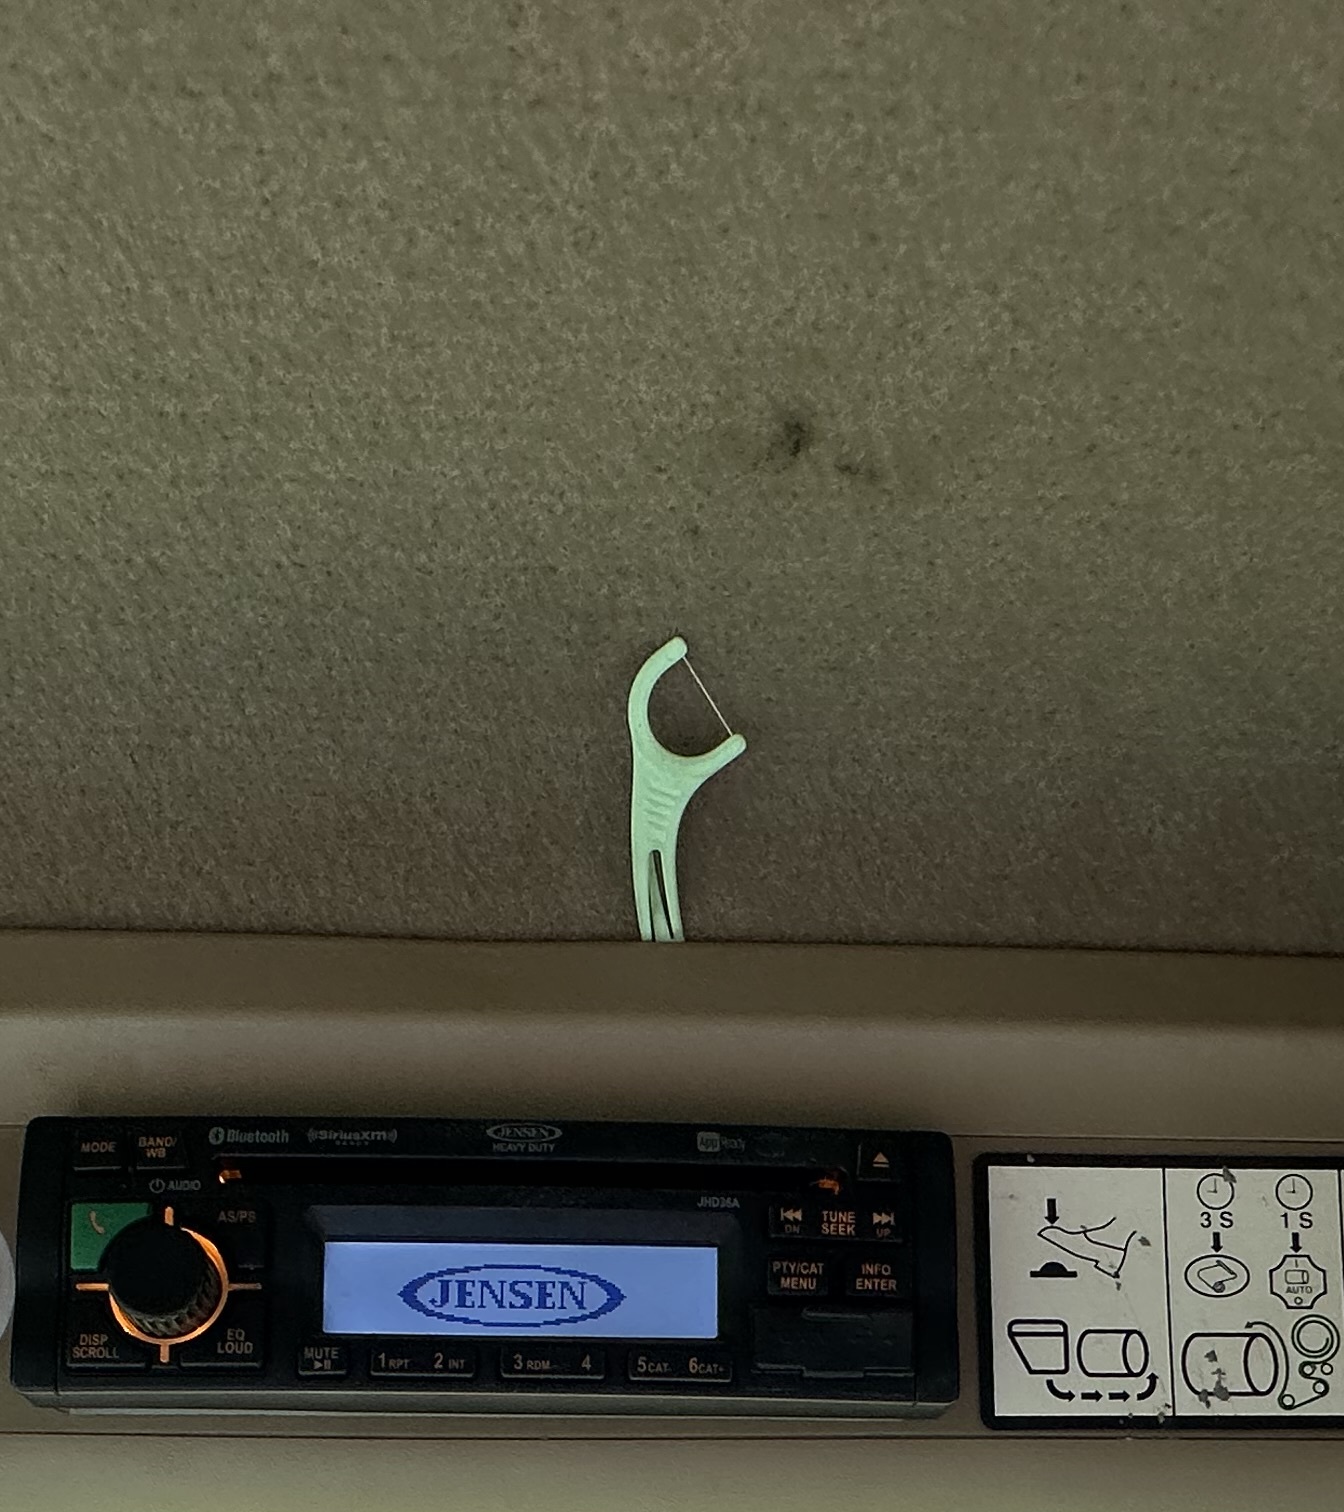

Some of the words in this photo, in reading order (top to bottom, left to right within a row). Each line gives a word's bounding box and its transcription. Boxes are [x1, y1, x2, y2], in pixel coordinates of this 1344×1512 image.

[226, 1128, 289, 1143] Bluetooth
[497, 1127, 550, 1138] JENSEN
[80, 1140, 117, 1153] MODE
[492, 1142, 526, 1152] HEAVY
[529, 1143, 555, 1152] DUTY
[145, 1148, 167, 1159] WB
[165, 1180, 202, 1191] AUDIO
[217, 1210, 257, 1224] AS/PS
[821, 1210, 856, 1223] TUNE
[1200, 1211, 1212, 1229] 3
[1219, 1211, 1234, 1229] S
[1280, 1212, 1289, 1229] 1
[1299, 1212, 1313, 1229] S
[821, 1223, 856, 1237] SEEK
[876, 1228, 892, 1238] UP
[772, 1261, 824, 1275] PTY/CAT
[861, 1263, 892, 1276] INFO
[780, 1277, 817, 1290] MENU
[856, 1278, 897, 1291] ENTER
[1285, 1286, 1313, 1294] AUTO
[428, 1279, 588, 1310] JENSEN
[79, 1333, 109, 1346] DISP
[226, 1328, 246, 1342] EQ
[72, 1347, 120, 1359] SCROLL
[217, 1342, 254, 1355] LOUD
[304, 1346, 339, 1359] MUTE
[378, 1352, 386, 1369] 1
[388, 1359, 410, 1370] RPT
[434, 1352, 444, 1369] 2
[448, 1359, 465, 1370] INT
[513, 1352, 523, 1370] 3
[526, 1360, 551, 1370] RDM
[580, 1353, 592, 1371] 4
[637, 1356, 647, 1373] 5
[688, 1357, 698, 1373] 6
